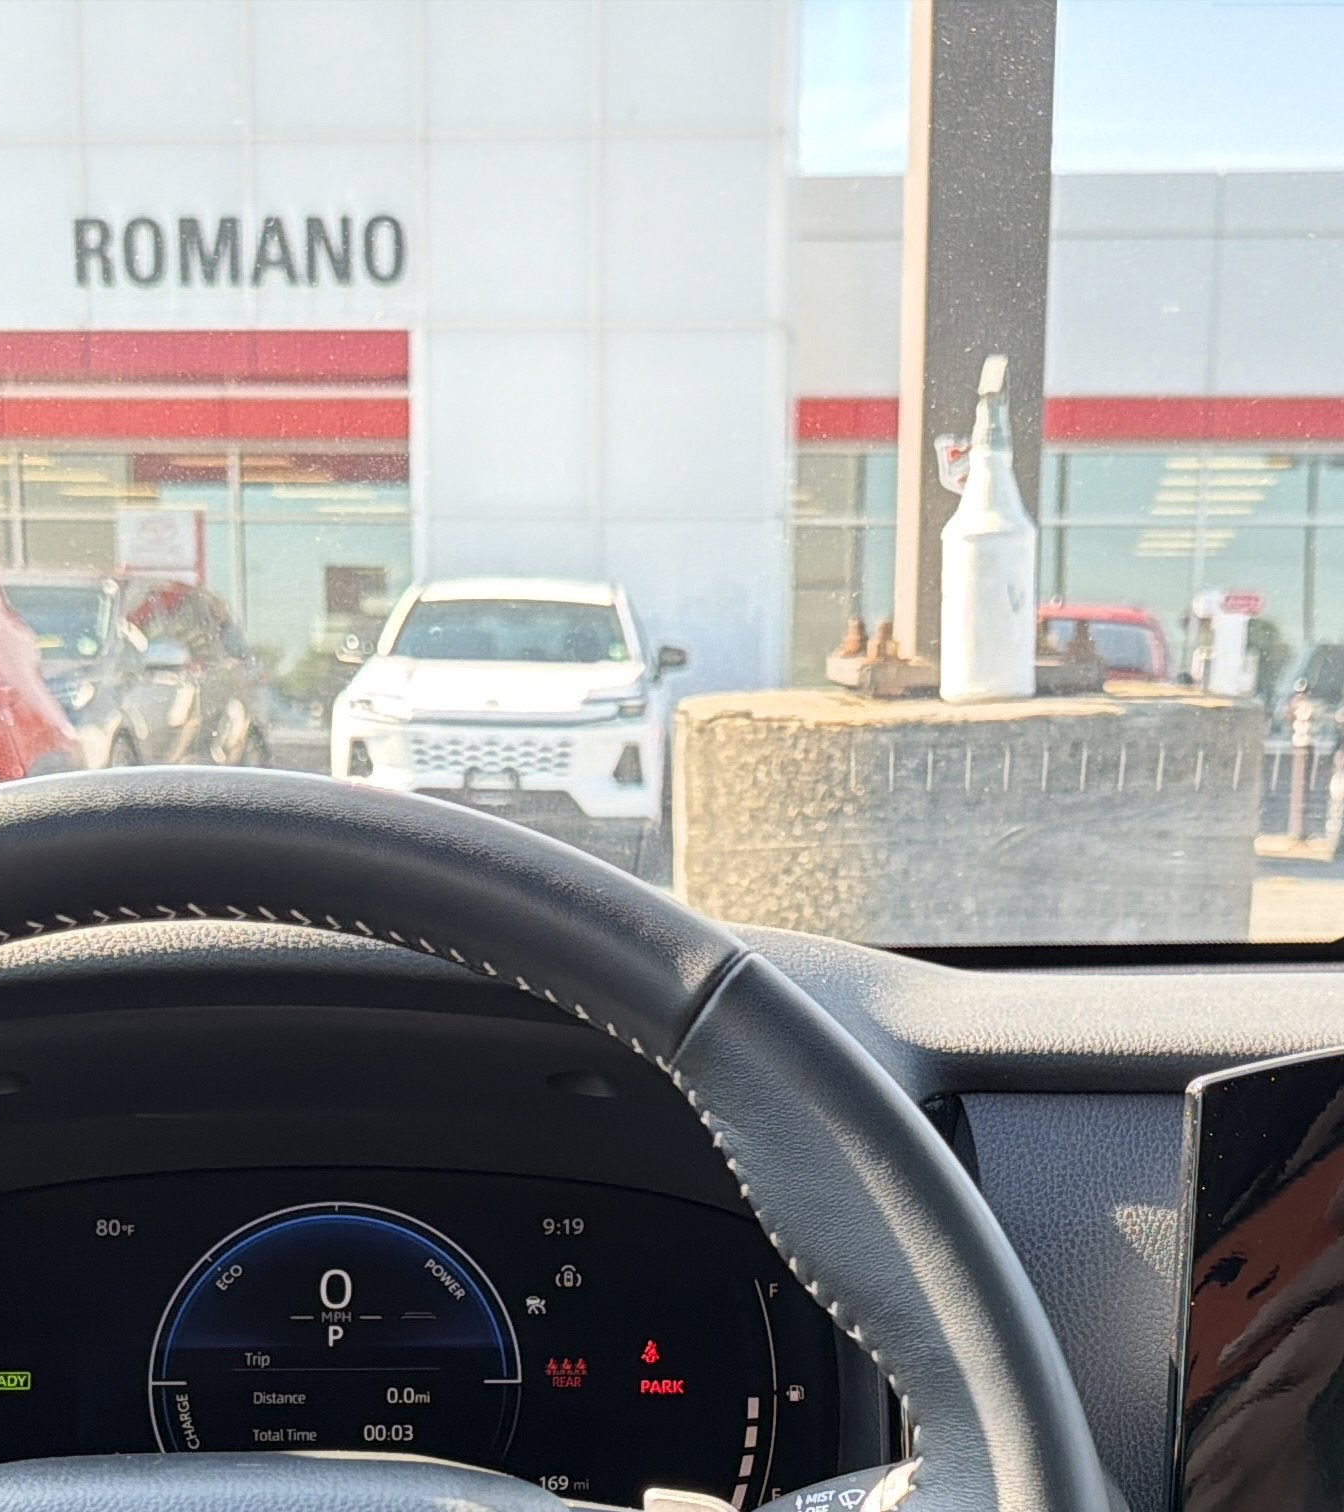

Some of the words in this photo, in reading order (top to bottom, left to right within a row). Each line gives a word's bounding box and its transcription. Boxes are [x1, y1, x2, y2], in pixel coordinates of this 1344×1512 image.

[72, 214, 405, 289] ROMANO
[542, 1218, 585, 1236] 9:19
[215, 1264, 243, 1292] ECO
[423, 1258, 466, 1301] POWER
[320, 1269, 353, 1310] 0
[769, 1283, 778, 1298] F
[321, 1311, 352, 1323] MPH
[328, 1326, 344, 1348] P
[245, 1352, 271, 1370] Trip
[552, 1376, 582, 1388] REAR
[640, 1379, 684, 1394] PARK
[253, 1391, 306, 1406] Distance
[176, 1394, 201, 1451] CHARGE
[253, 1427, 285, 1443] Total
[287, 1427, 318, 1443] Time
[363, 1424, 414, 1443] 00:03
[539, 1475, 569, 1491] 169
[573, 1477, 590, 1490] mi
[805, 1490, 836, 1505] MIST
